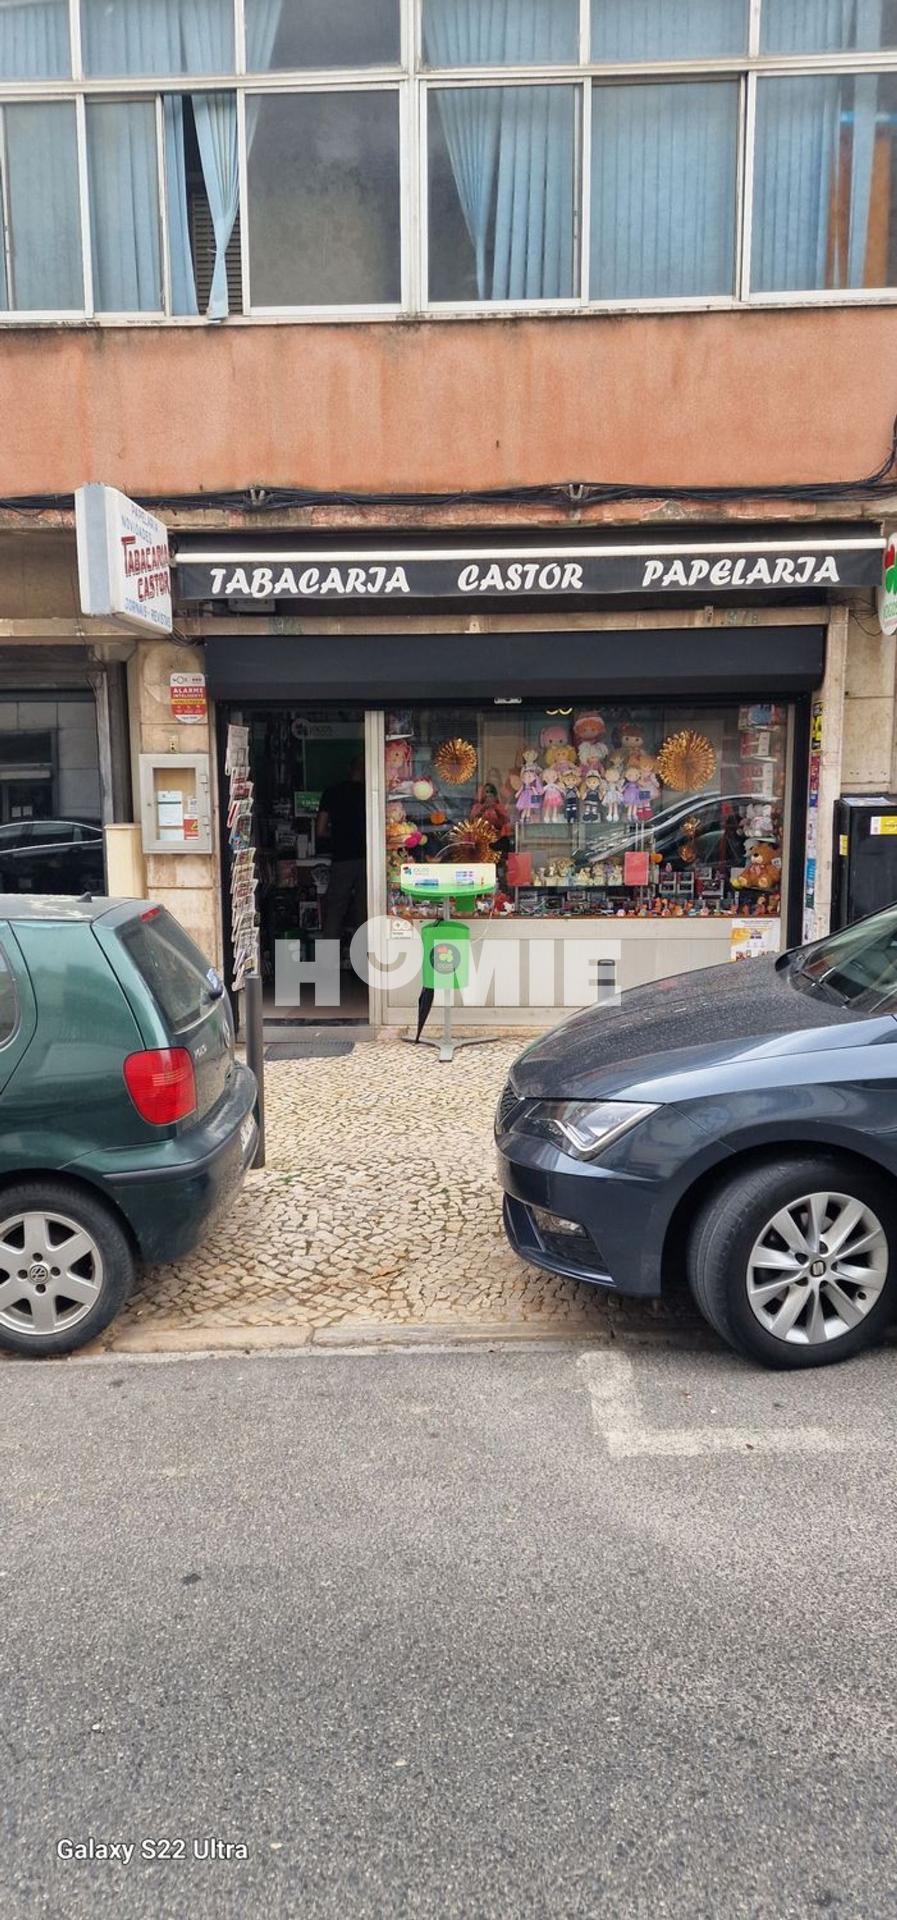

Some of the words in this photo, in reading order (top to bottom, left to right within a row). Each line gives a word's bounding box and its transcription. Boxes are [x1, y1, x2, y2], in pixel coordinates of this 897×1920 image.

[121, 535, 169, 578] TABACARIA
[137, 571, 170, 602] CASTOR
[457, 563, 583, 592] CASTOR
